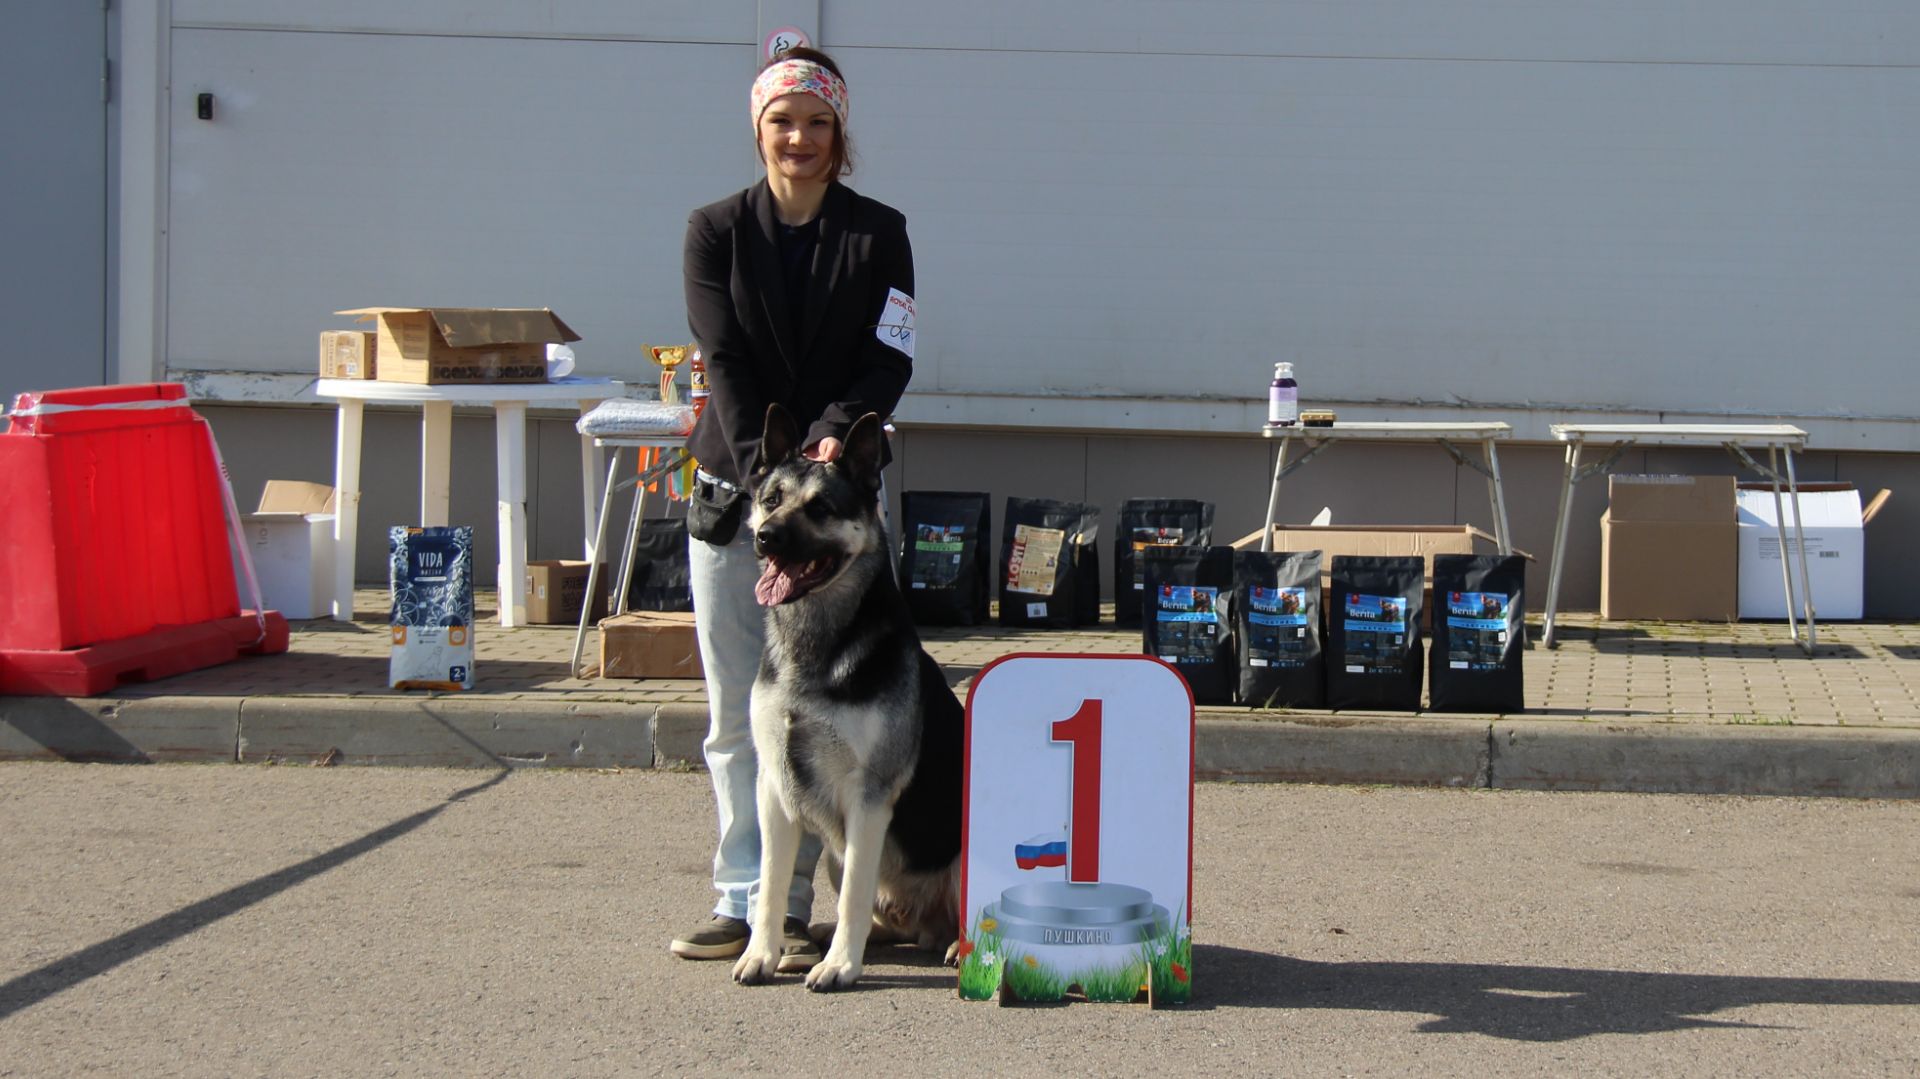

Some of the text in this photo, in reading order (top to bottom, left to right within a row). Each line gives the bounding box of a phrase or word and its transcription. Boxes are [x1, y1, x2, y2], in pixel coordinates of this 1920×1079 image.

[418, 551, 443, 568] VIDA
[1162, 600, 1188, 610] Berita
[1253, 602, 1277, 613] Berita
[1350, 609, 1376, 619] Berita
[1451, 607, 1478, 617] Berita
[1051, 698, 1103, 884] 1
[1044, 928, 1112, 943] ПУШКИНО
